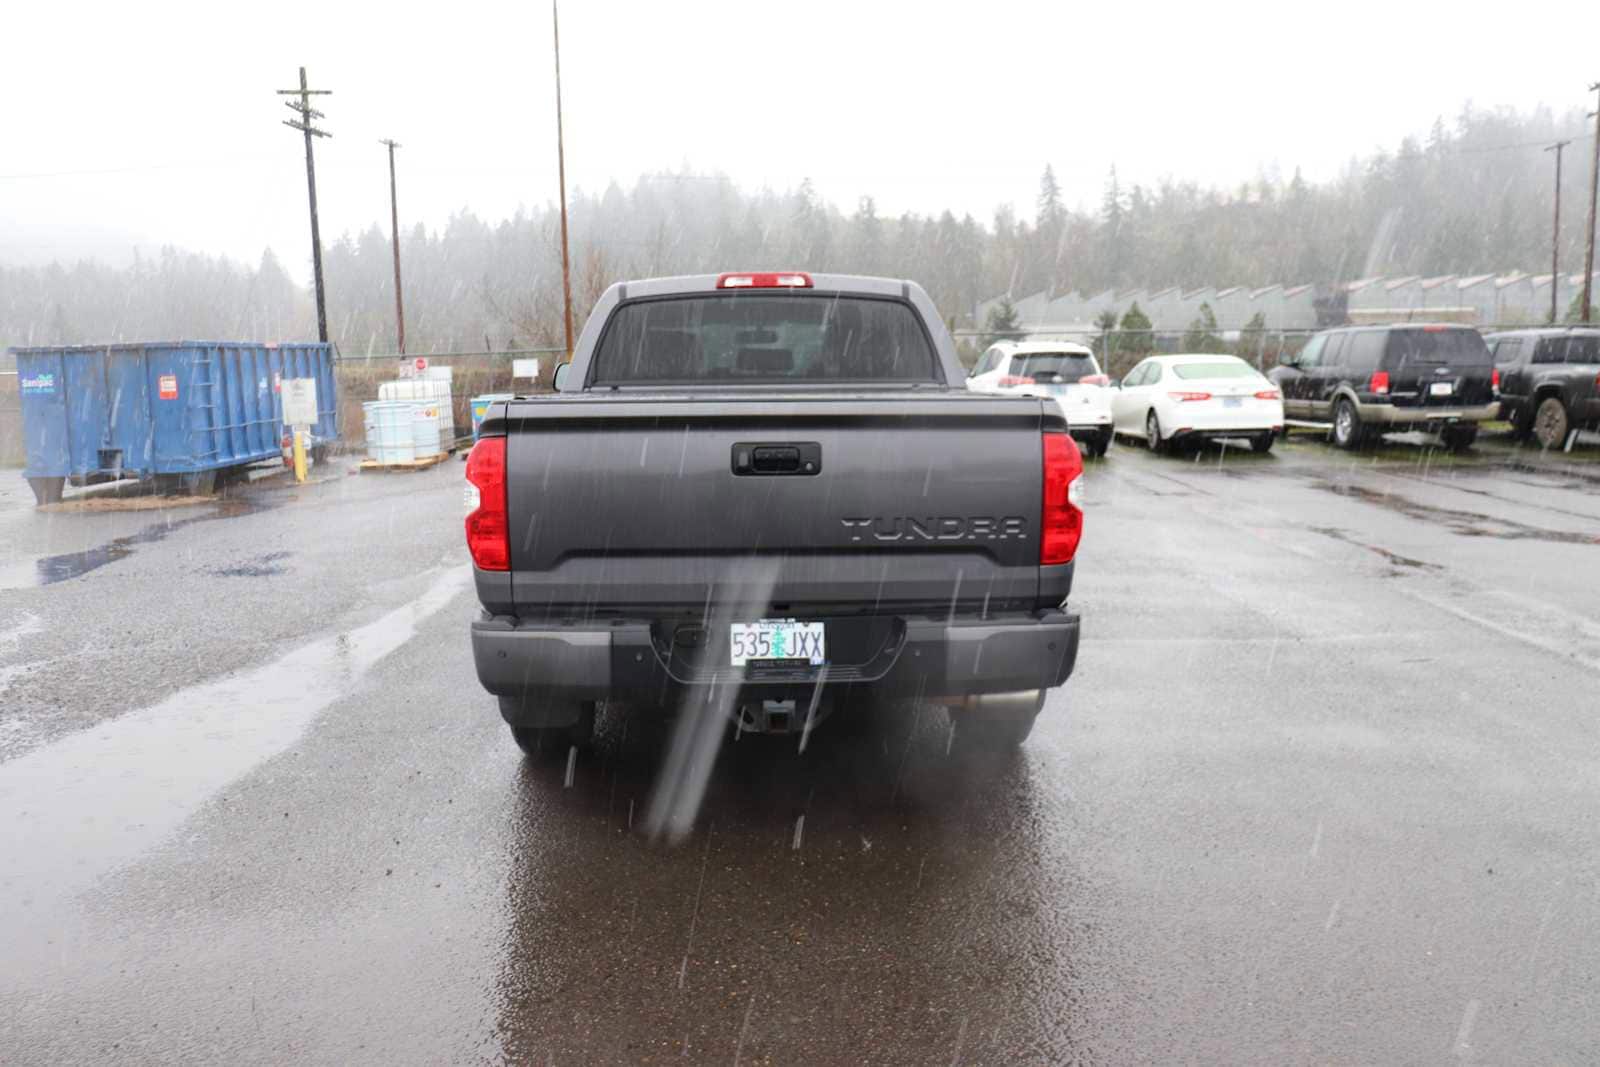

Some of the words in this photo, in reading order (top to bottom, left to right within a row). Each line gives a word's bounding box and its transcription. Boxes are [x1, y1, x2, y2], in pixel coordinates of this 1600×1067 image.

[841, 516, 1026, 541] TUNDRA
[733, 631, 770, 658] 535
[785, 631, 822, 657] JXX
